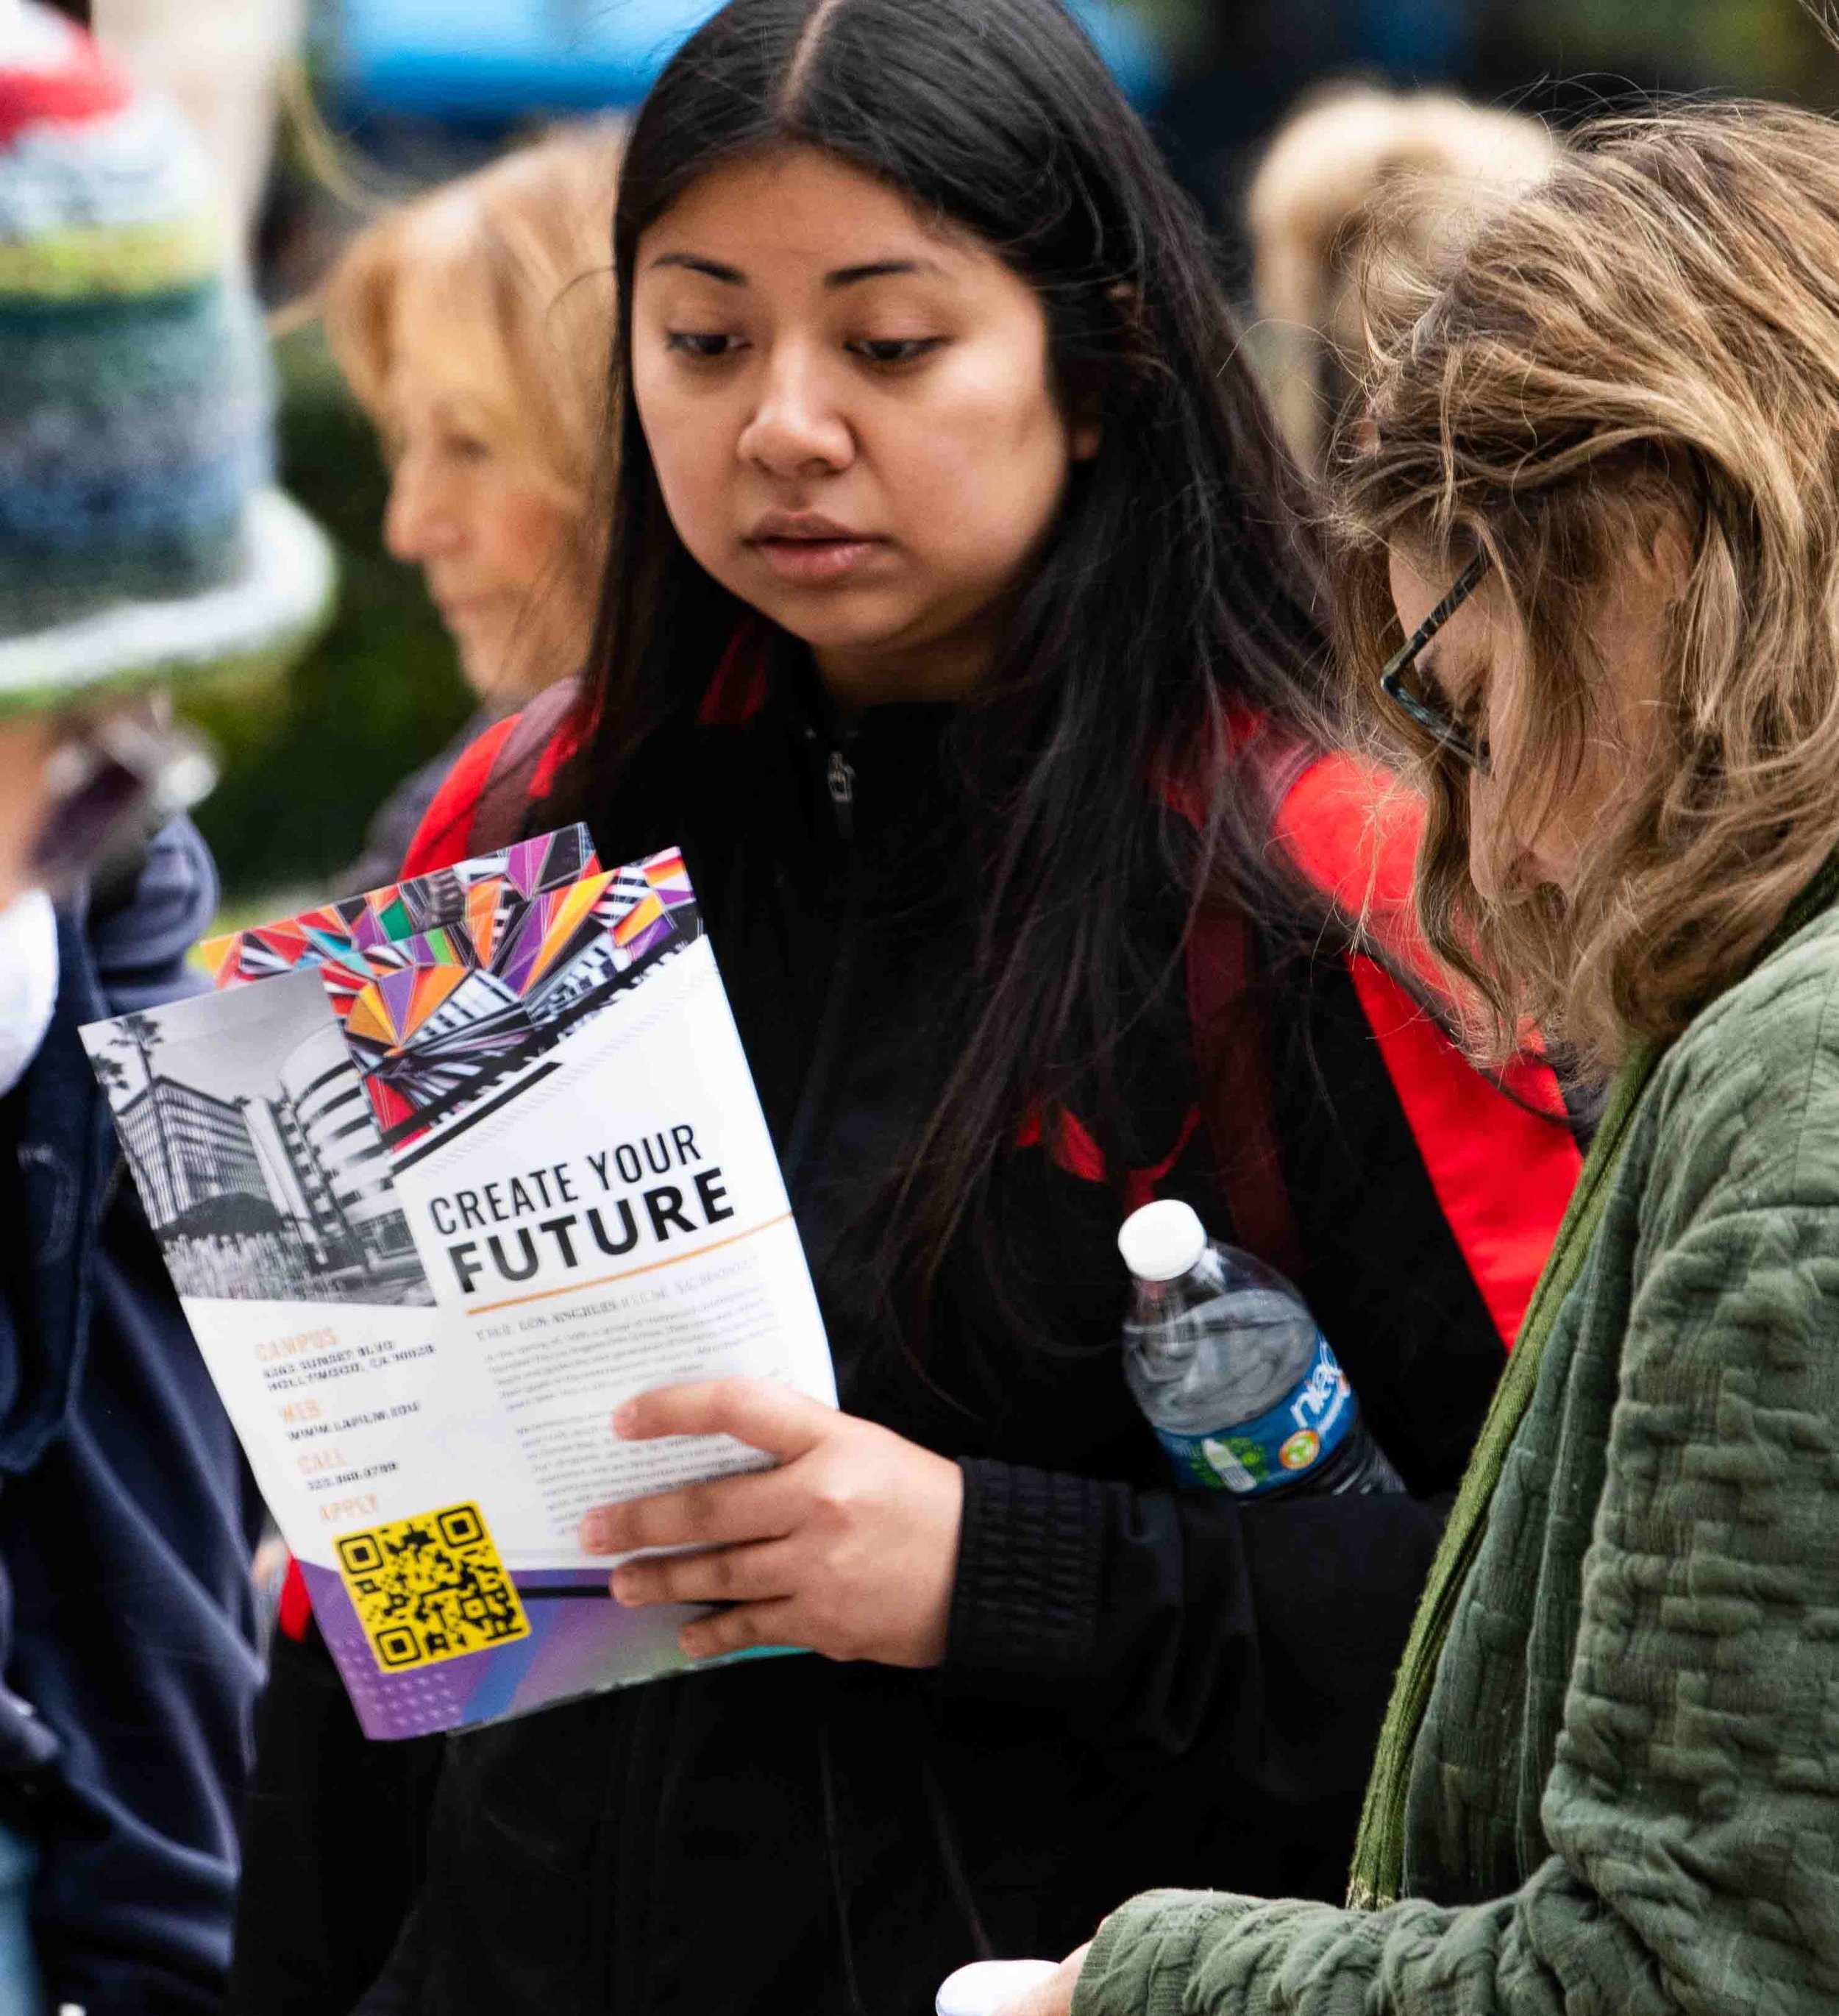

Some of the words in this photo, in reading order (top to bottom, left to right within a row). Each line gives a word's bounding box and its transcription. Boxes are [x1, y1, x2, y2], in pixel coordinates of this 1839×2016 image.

[428, 1163, 579, 1235] CREATE
[586, 1124, 702, 1190] YOUR
[447, 1167, 734, 1293] FUTURE
